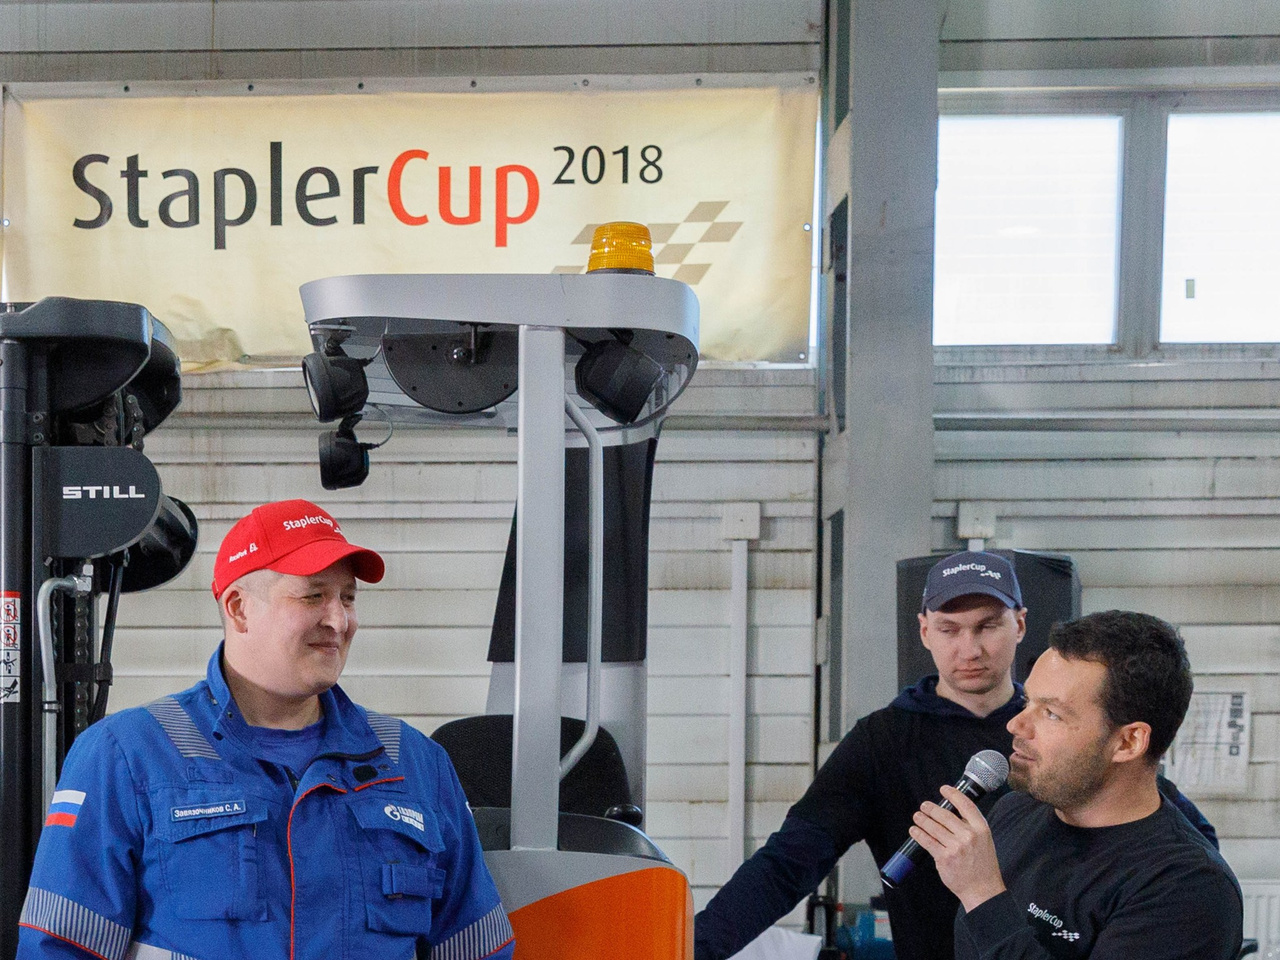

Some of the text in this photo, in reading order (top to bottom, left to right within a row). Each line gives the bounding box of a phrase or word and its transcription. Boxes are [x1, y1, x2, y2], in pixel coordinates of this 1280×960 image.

[72, 141, 664, 250] StaplerCup 2018
[62, 486, 145, 499] STILL
[283, 515, 334, 531] StaplerCup
[942, 563, 986, 577] StaplerCup
[1027, 902, 1063, 929] StaplerCup
